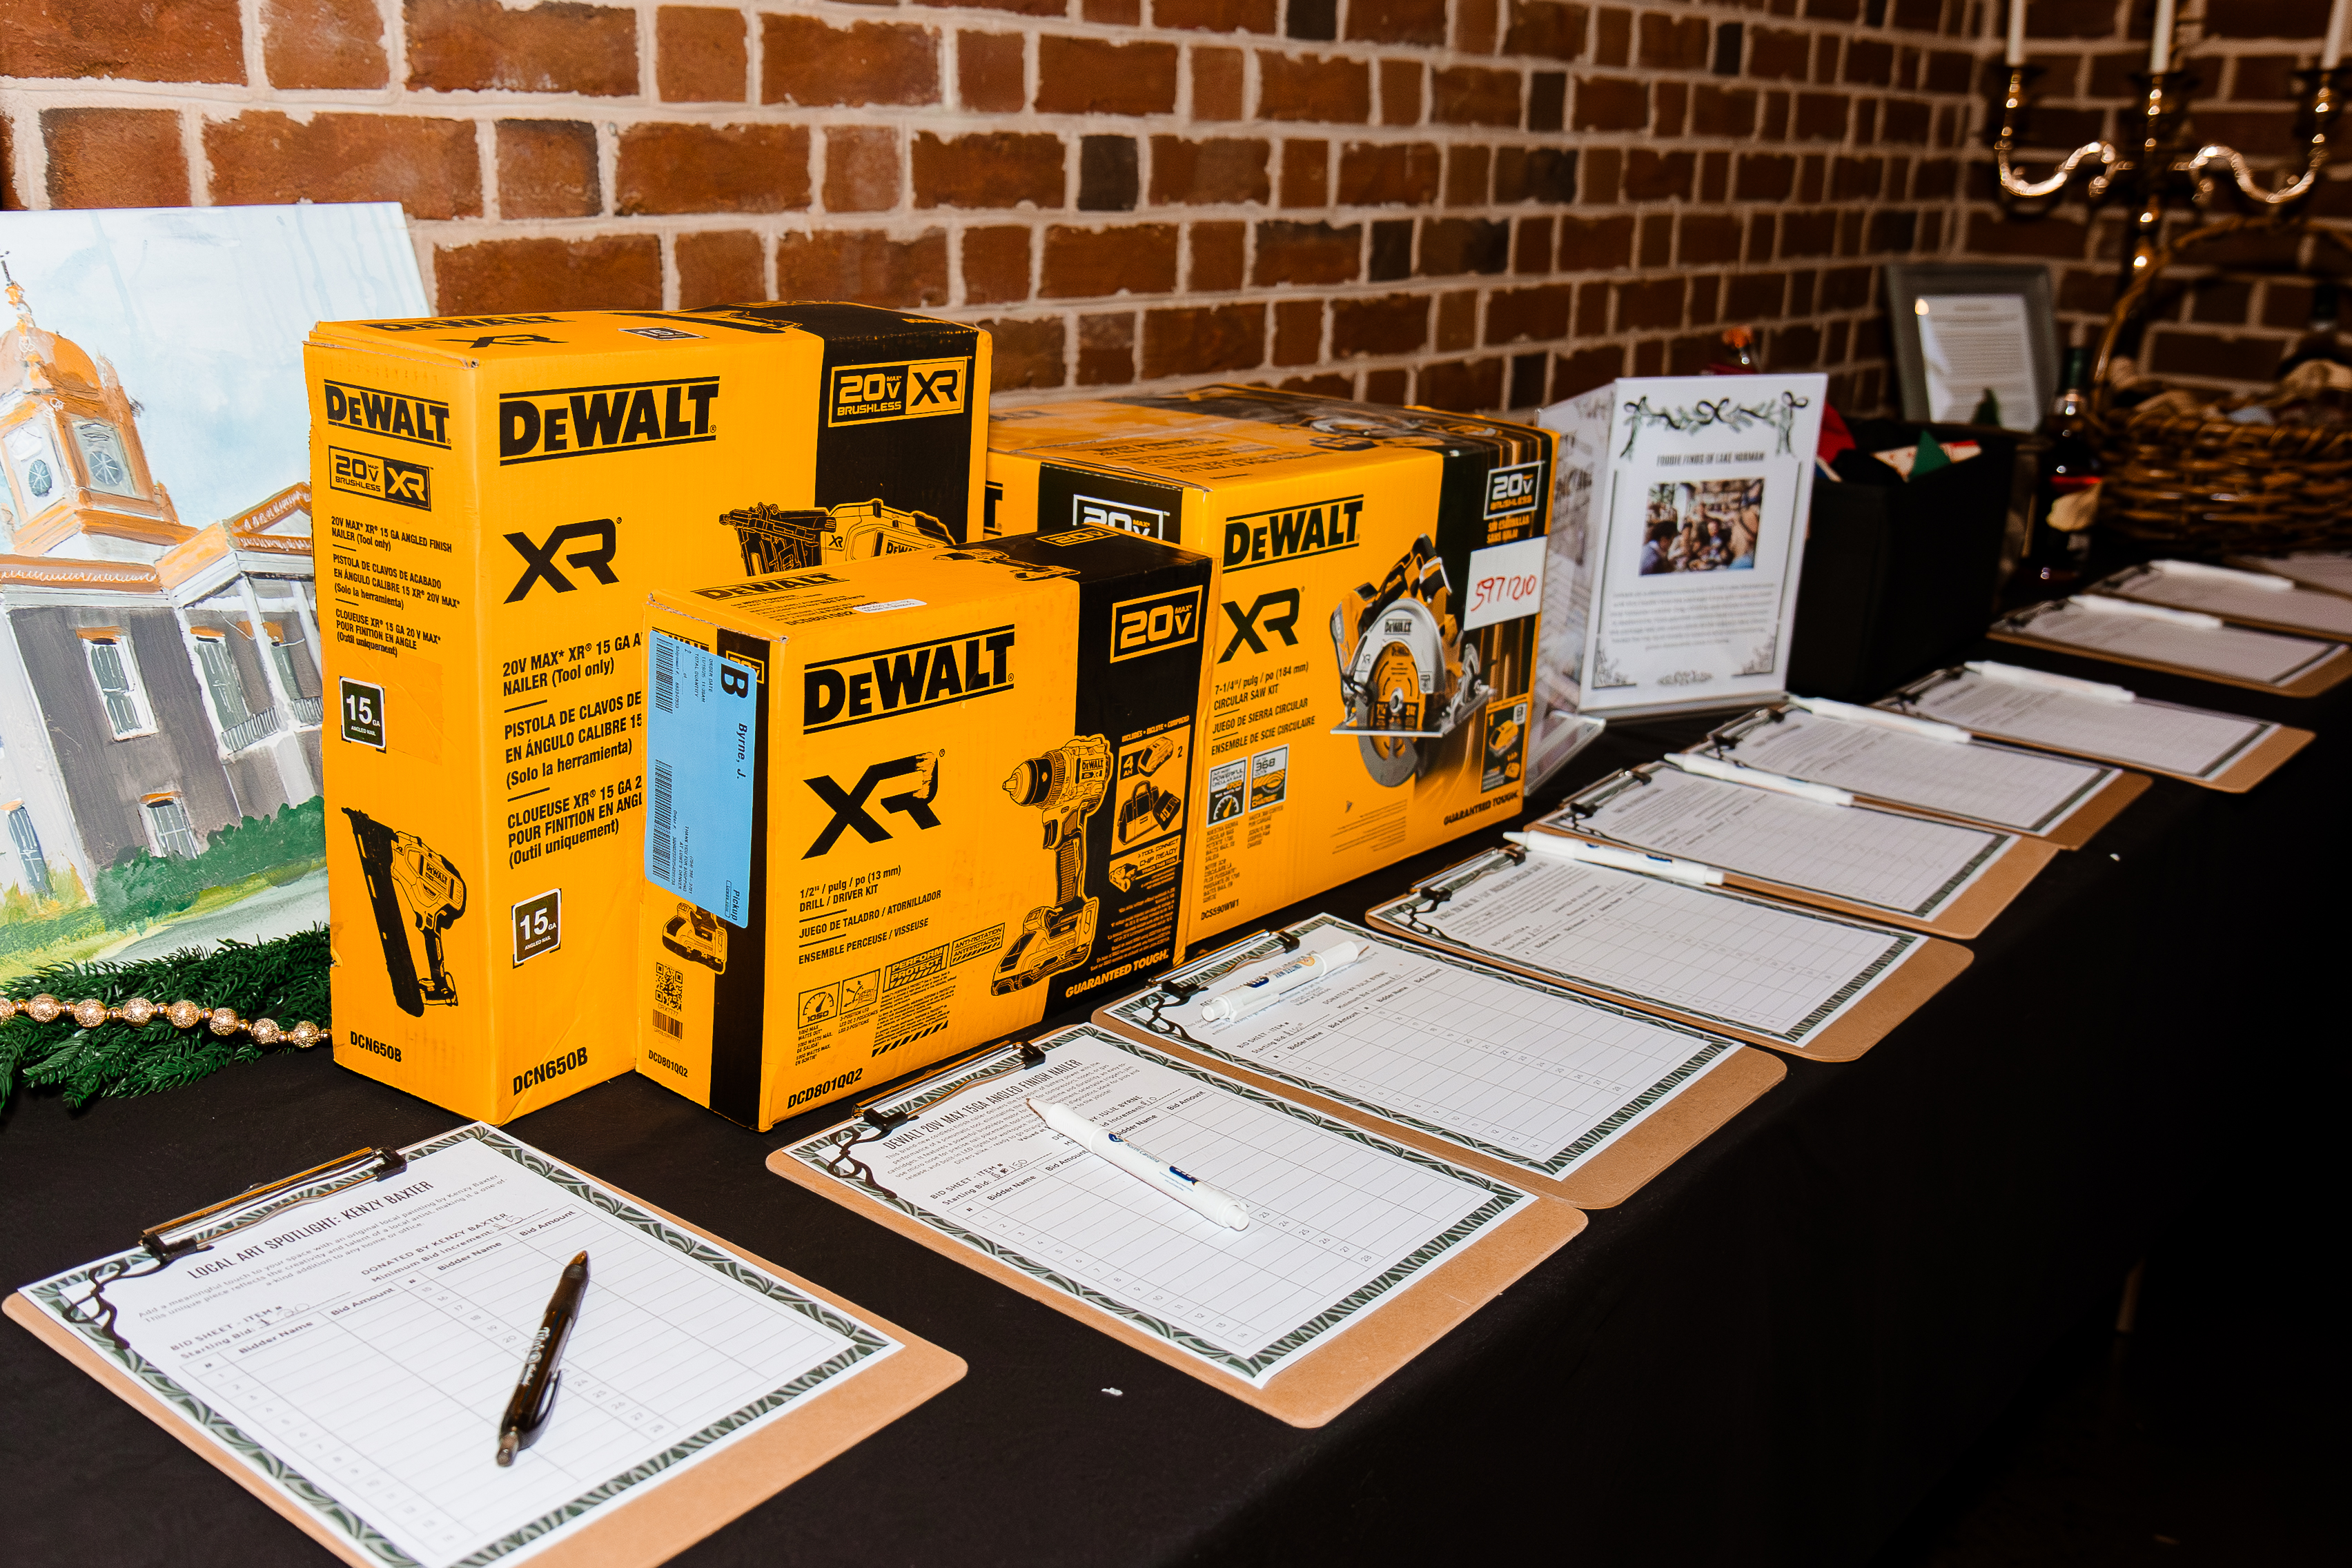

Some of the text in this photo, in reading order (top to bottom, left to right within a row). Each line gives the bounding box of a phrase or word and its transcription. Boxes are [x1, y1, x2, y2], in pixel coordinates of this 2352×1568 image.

[910, 369, 959, 406] XR
[500, 383, 719, 458] DEWALT
[837, 402, 901, 416] BRUSHLESS
[335, 476, 380, 491] BRUSHLESS
[387, 467, 426, 501] XR
[331, 516, 343, 525] 20V
[380, 527, 388, 537] 15
[391, 530, 400, 540] GA
[401, 532, 427, 547] ANGLED
[430, 539, 451, 553] FINISH
[332, 527, 391, 551] NAILER (Tool only)
[1223, 500, 1363, 567] DEWALT
[503, 518, 620, 604] XR
[1217, 588, 1300, 664] XR
[503, 659, 527, 677] 20V
[596, 640, 610, 655] 15
[615, 635, 630, 651] GA
[504, 657, 614, 696] NAILER (Tool only)
[803, 631, 1015, 727] DEWALT
[1244, 675, 1258, 689] pulg
[1265, 672, 1273, 683] po
[1276, 666, 1291, 680] (184
[346, 695, 372, 724] 15
[505, 691, 642, 739] PISTOLA DE CLAVOS DE
[1213, 698, 1308, 734] JUEGO DE SIERRA CIRCULAR
[1214, 684, 1280, 710] CIRCULAR SAW KIT
[506, 713, 642, 763] EN ÁNGULO CALIBRE 15
[721, 663, 748, 780] B Byrne, J.
[1212, 716, 1315, 756] ENSEMBLE DE SCIE CIRCULAIRE
[507, 738, 632, 790] (Solo la herramienta)
[1124, 745, 1182, 770] 4 2
[508, 799, 570, 829] CLOUEUSE
[600, 785, 614, 801] 15
[618, 779, 632, 794] GA
[509, 825, 541, 847] POUR
[546, 807, 595, 836] FINITION
[599, 802, 614, 819] EN
[509, 819, 620, 870] (Outil uniquement)
[800, 884, 878, 912] DRILL DRIVER KIT
[828, 880, 847, 894] pulg
[855, 876, 865, 887] po
[868, 870, 881, 884] (13
[883, 865, 901, 879] mm)
[520, 908, 548, 940] 15
[732, 890, 740, 921] Pickup
[799, 890, 941, 939] JUEGO DE TALADRO ATORNILLADOR
[798, 918, 928, 964] ENSEMBLE PERCEUSE VISSEUSE
[892, 947, 943, 971] PERFORM
[1066, 963, 1131, 997] GUARANTEED
[350, 1030, 402, 1062] DCN650B
[649, 1049, 687, 1077] DCD801QQ2
[513, 1046, 588, 1097] DCN650B
[787, 1068, 863, 1109] DCD801QQ2
[883, 1059, 1083, 1150] DEWALT 20V MAX 15GA ANGLED FINISH NAILER
[1099, 1095, 1143, 1118] JULIE BYRNE
[186, 1181, 434, 1279] LOCAL ART SPOTLIGHT: KENZY BAXTER
[361, 1213, 508, 1275] DONATED BY KENZY BAXTER
[371, 1228, 494, 1282] Minimum Bid Increment:
[170, 1324, 233, 1351] BID SHEET
[238, 1287, 395, 1354] Bidder Name Bid Amount
[181, 1327, 255, 1359] Starting Bid:
